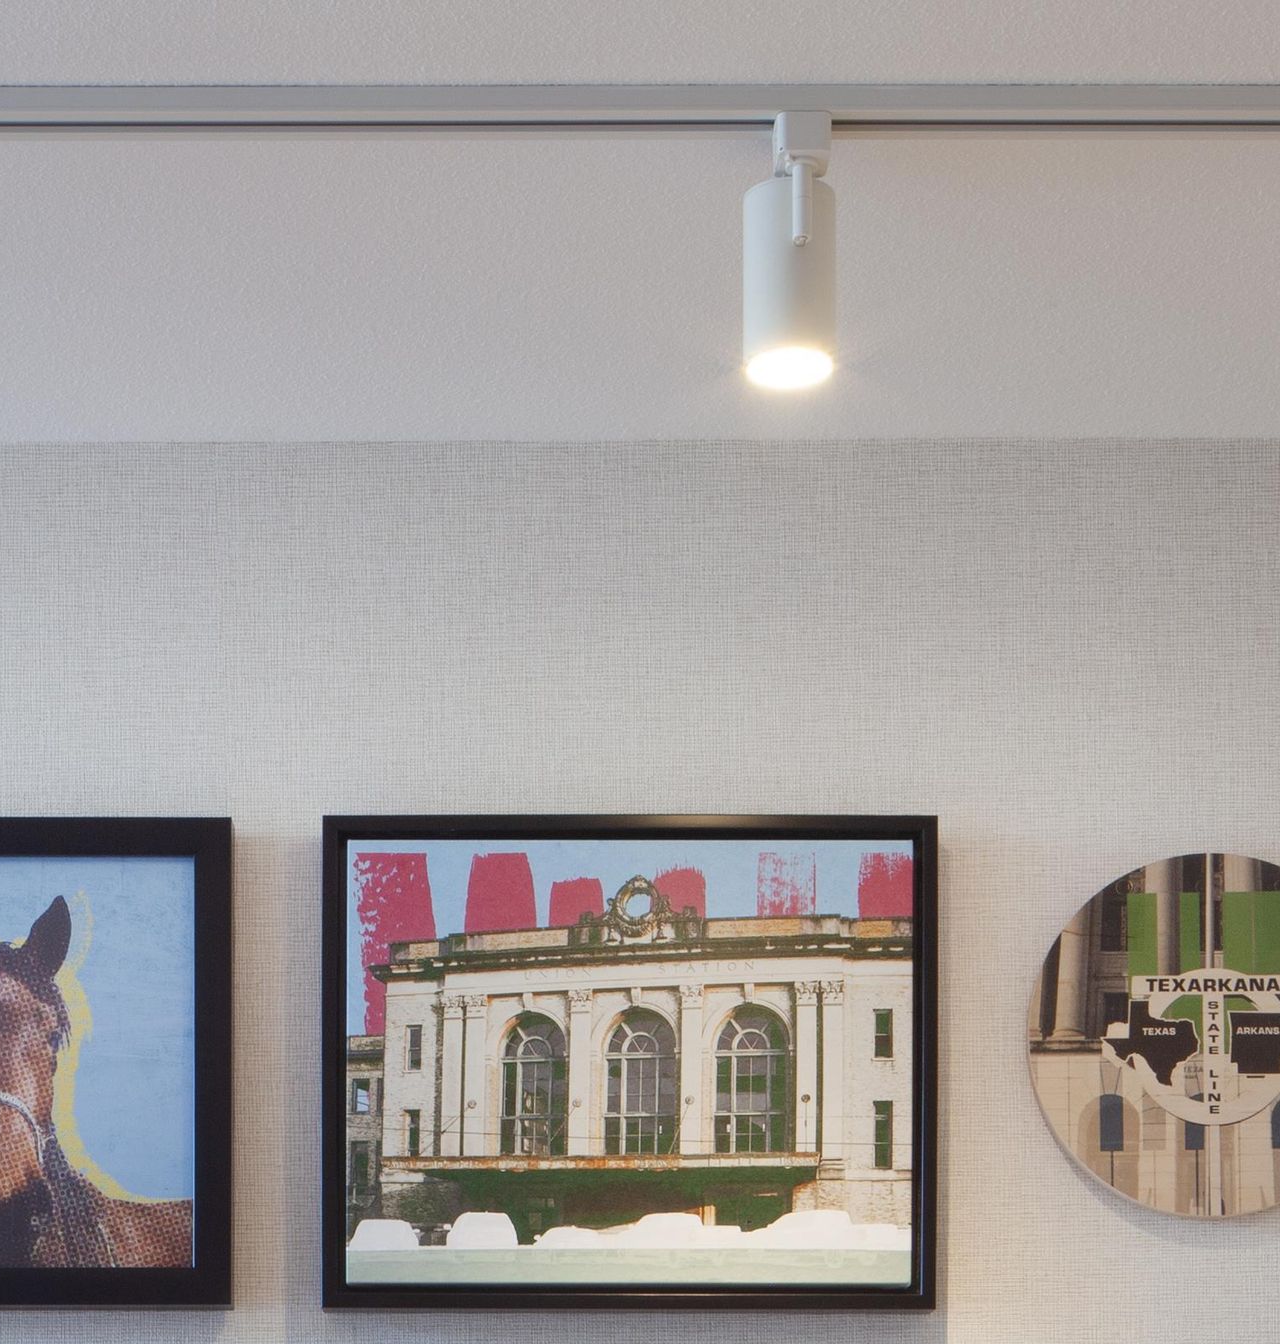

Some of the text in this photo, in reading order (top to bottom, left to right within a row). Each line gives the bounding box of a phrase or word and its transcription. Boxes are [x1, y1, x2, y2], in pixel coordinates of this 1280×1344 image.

[658, 960, 756, 976] STATION
[1146, 978, 1280, 992] TEXARKANA
[1142, 1026, 1176, 1036] TEXAS
[1208, 1001, 1221, 1115] STATE LINE
